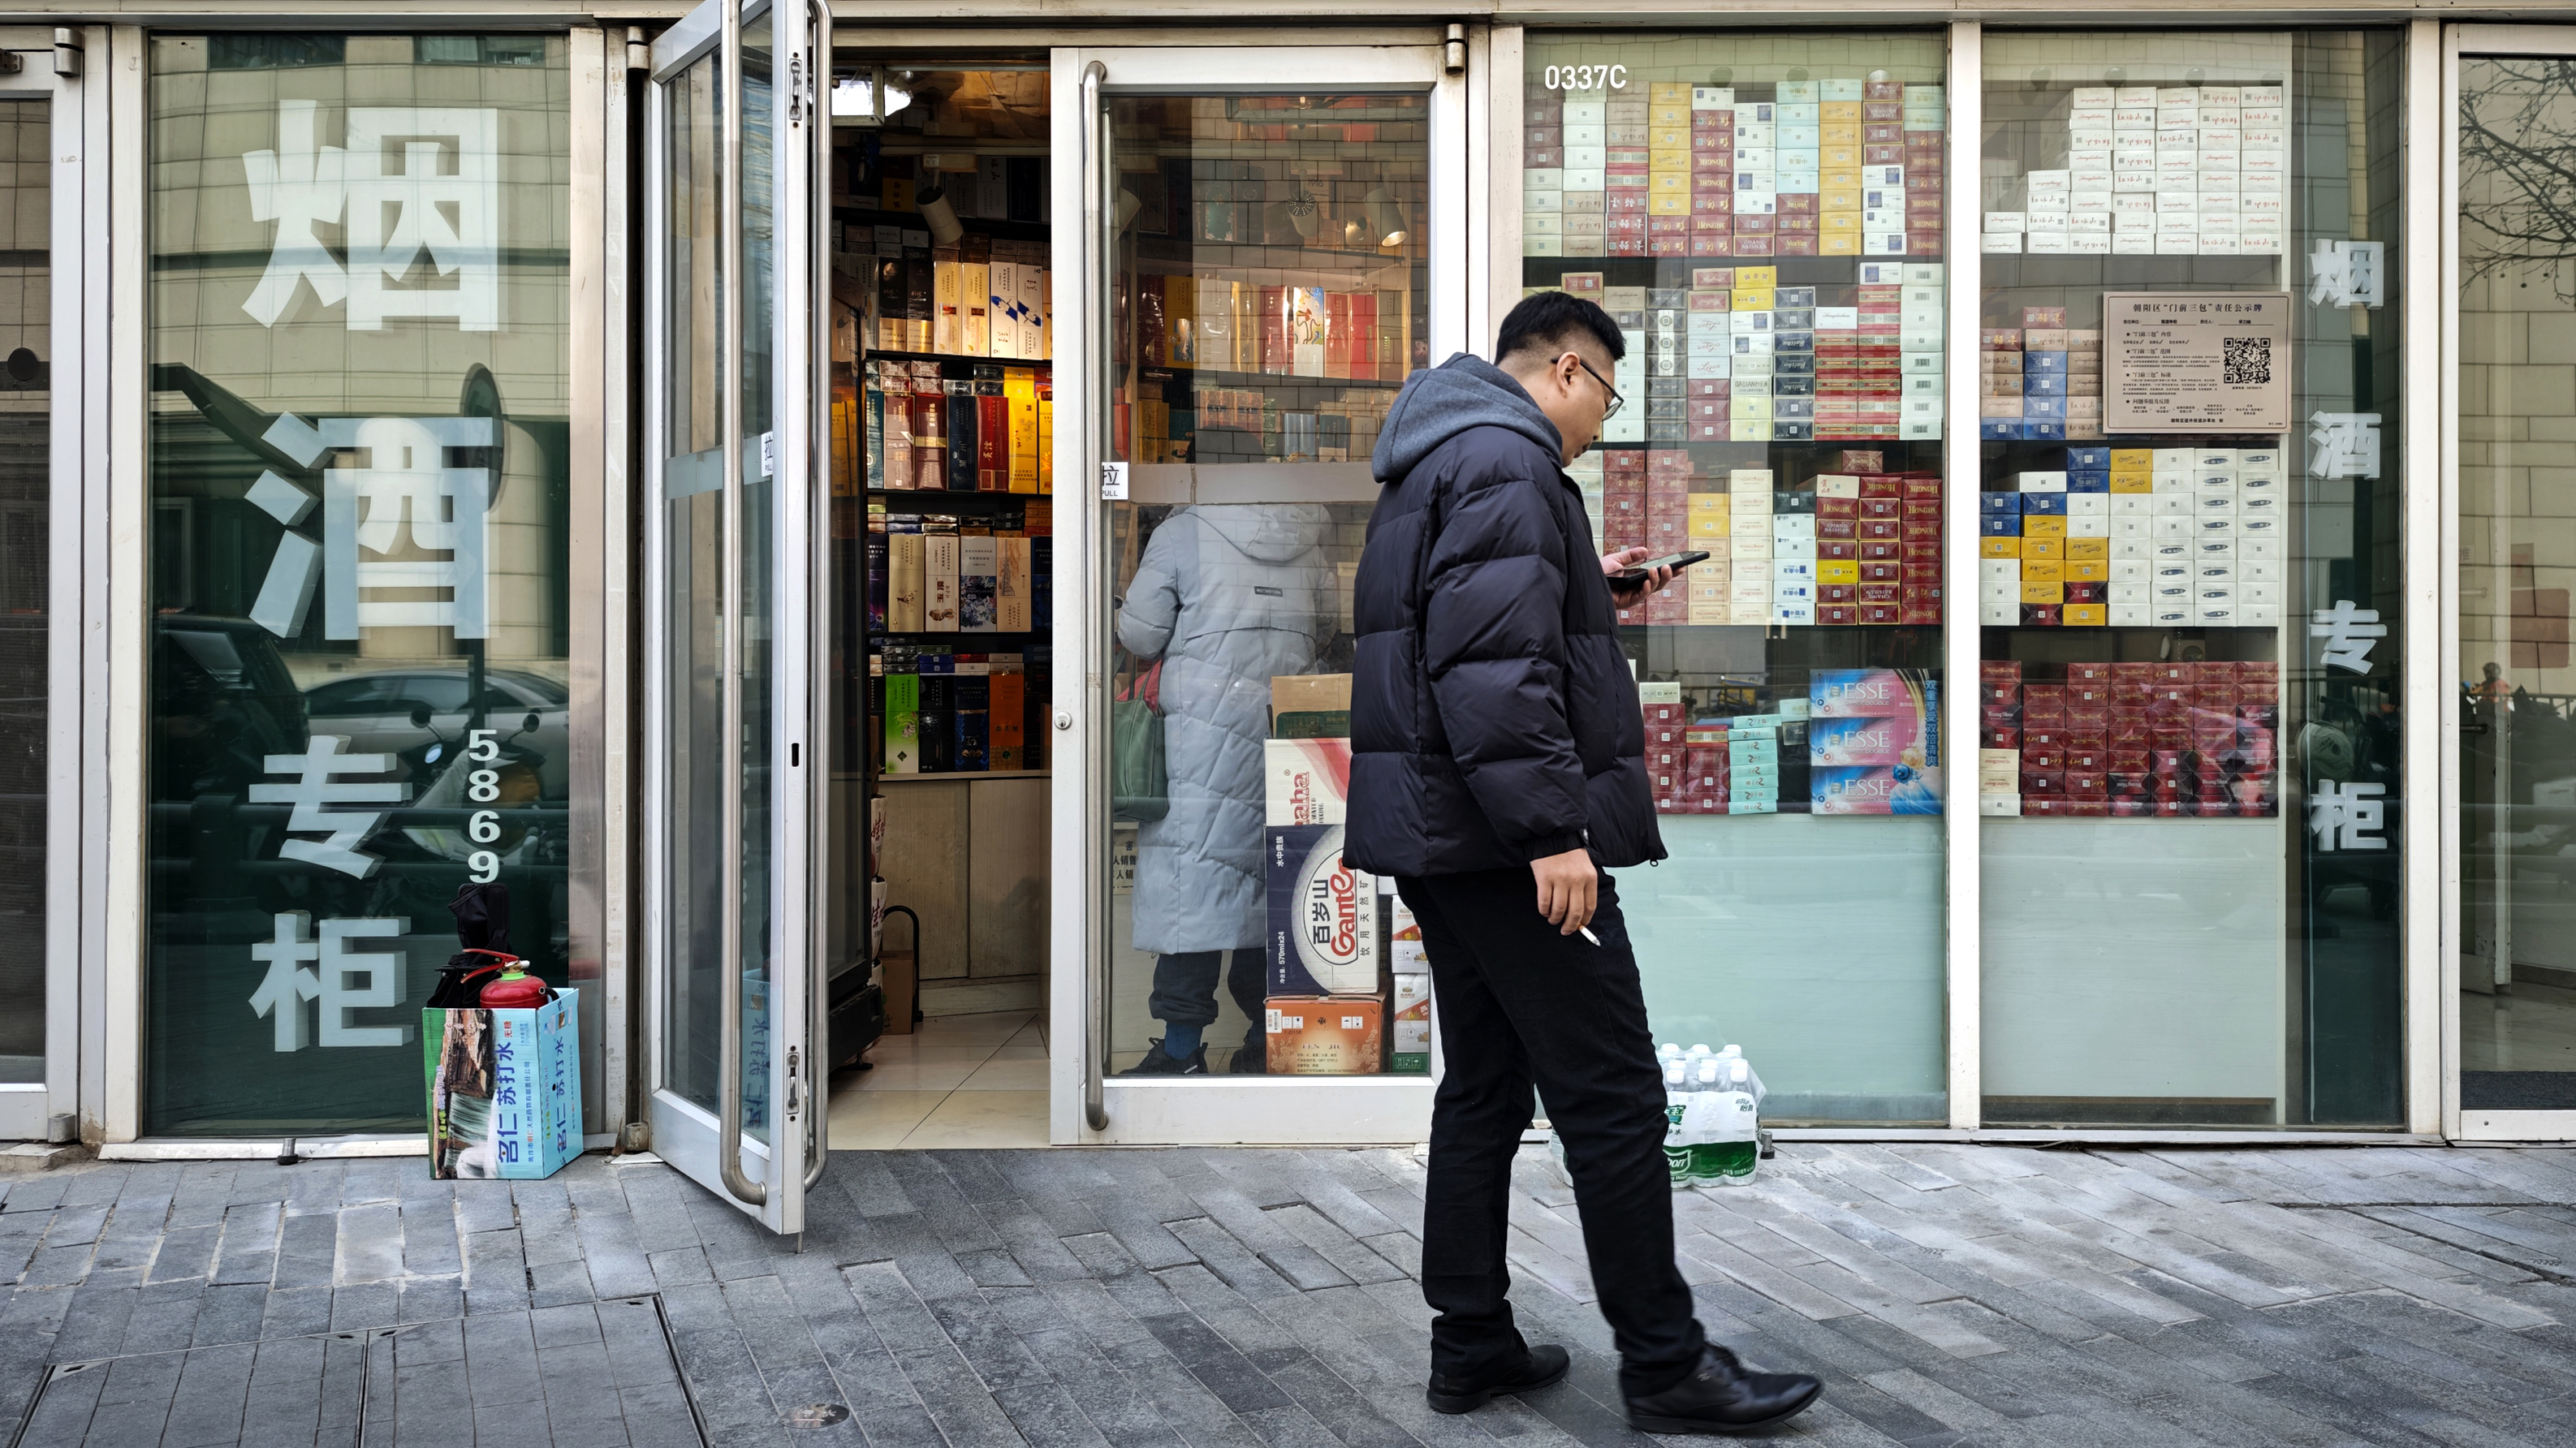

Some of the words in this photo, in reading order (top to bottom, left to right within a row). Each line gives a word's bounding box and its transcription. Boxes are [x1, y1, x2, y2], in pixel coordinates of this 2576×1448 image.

[1544, 64, 1627, 89] 0337C
[1697, 220, 1727, 230] HONGHE
[1866, 484, 1896, 492] HONGHE
[1823, 503, 1852, 513] HONGHE
[1908, 506, 1937, 515] HONGHE
[1908, 547, 1936, 556] HONGHE
[2307, 238, 2387, 851] 烟酒专柜
[241, 99, 502, 1053] 烟酒专柜
[1908, 567, 1937, 577] HONGHE
[1908, 610, 1936, 618] HONGHE
[1844, 683, 1890, 700] ESSE
[1926, 679, 1939, 767] 双重享受双倍清爽
[1844, 730, 1890, 748] ESSE
[1844, 779, 1891, 796] ESSE
[468, 729, 502, 884] 5869
[1275, 835, 1284, 867] 水中贵族
[1312, 878, 1331, 945] 百岁山
